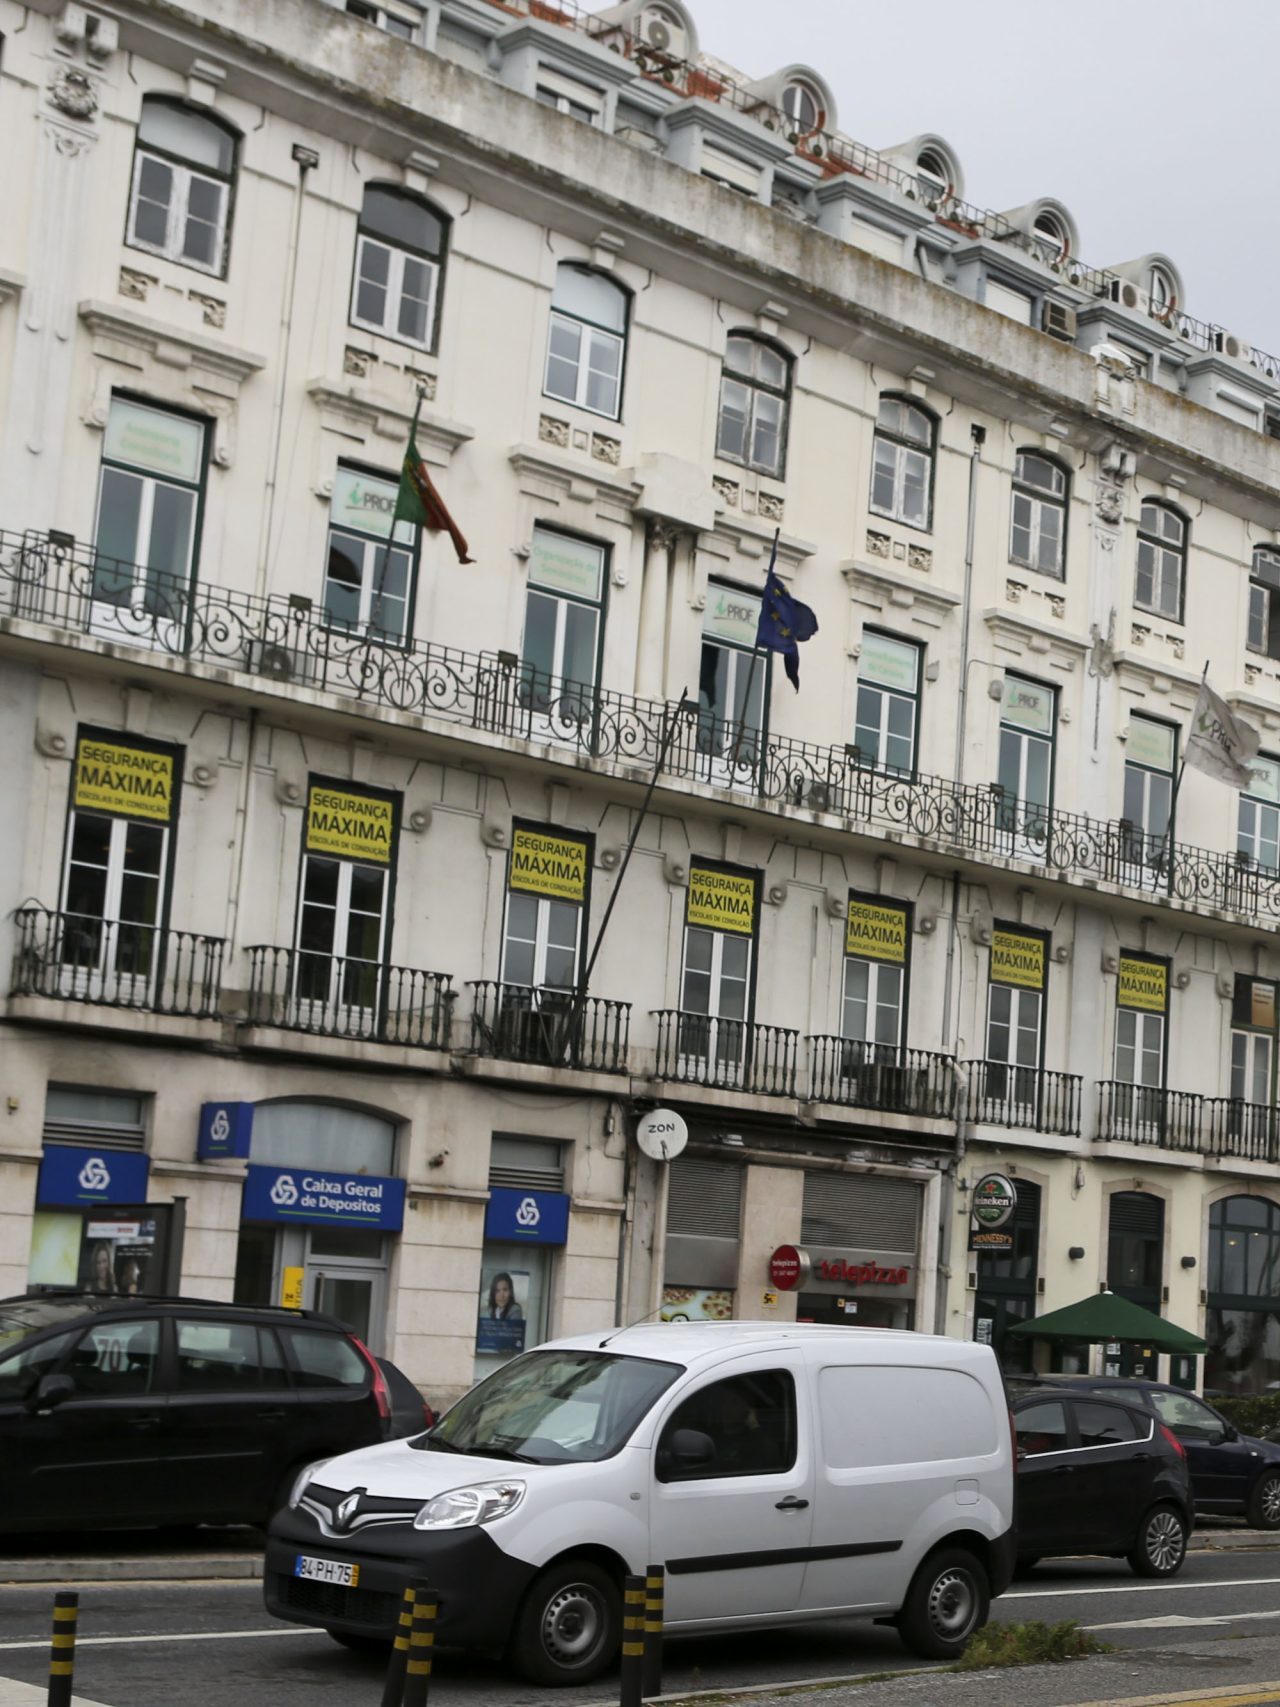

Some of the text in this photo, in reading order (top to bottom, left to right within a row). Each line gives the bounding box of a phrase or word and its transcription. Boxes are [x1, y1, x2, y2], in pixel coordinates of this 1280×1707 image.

[82, 745, 169, 777] SEGURANÇA
[80, 765, 167, 800] MÁXIMA
[313, 793, 389, 821] SEGURANÇA
[311, 811, 388, 844] MÁXIMA
[516, 835, 583, 862] SEGURANÇA
[514, 852, 582, 883] MÁXIMA
[692, 873, 751, 896] SEGURANÇA
[691, 888, 750, 916] MÁXIMA
[850, 906, 904, 928] SEGURANÇA
[849, 919, 903, 946] MÁXIMA
[994, 935, 1042, 956] SEGURANÇA
[993, 949, 1041, 974] MÁXIMA
[1121, 962, 1165, 980] SEGURANÇA
[1120, 974, 1164, 998] MÁXIMA
[647, 1122, 675, 1133] ZON
[302, 1177, 383, 1198] Caixa Geral
[300, 1195, 381, 1213] de Depositos
[820, 1258, 908, 1287] telepizza
